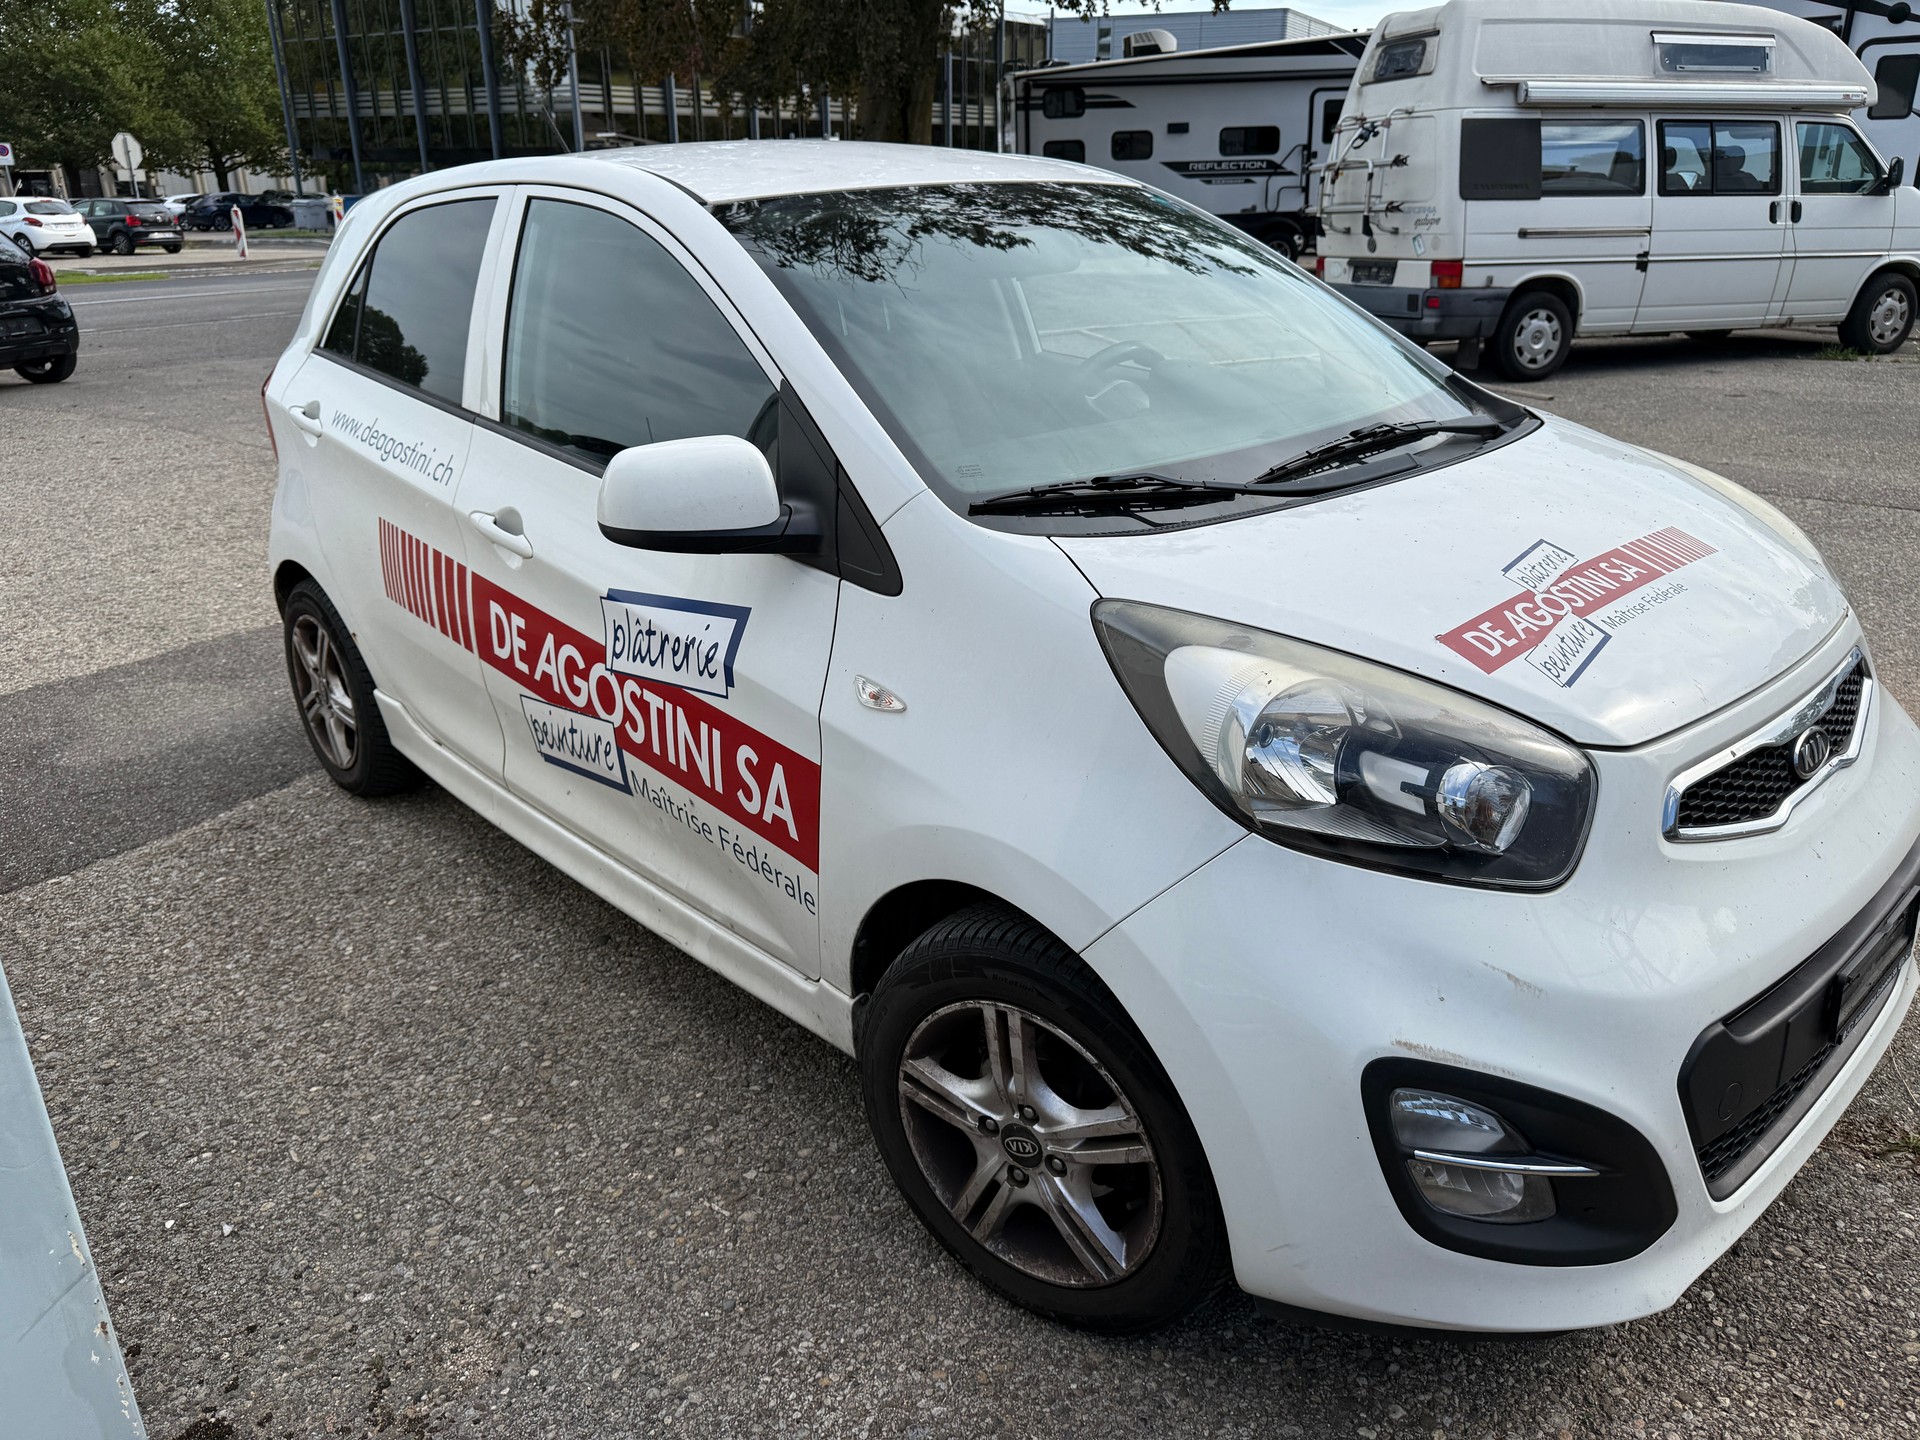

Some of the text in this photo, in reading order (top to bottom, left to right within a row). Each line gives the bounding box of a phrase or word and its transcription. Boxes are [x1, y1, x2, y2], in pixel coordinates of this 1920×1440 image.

[1189, 161, 1268, 171] REFLECTION
[331, 410, 453, 487] www.deagostini.ch
[1517, 549, 1568, 588] plâtrerie
[1462, 557, 1648, 658] DE AGOSTINI SA
[1601, 582, 1688, 630] Maîtrise Fédérale
[611, 608, 720, 679] plâtrerie
[1539, 620, 1595, 679] peinture
[490, 600, 799, 842] DE AGOSTINI SA
[530, 710, 614, 770] peinture
[631, 770, 816, 915] Maîtrise Fédérale
